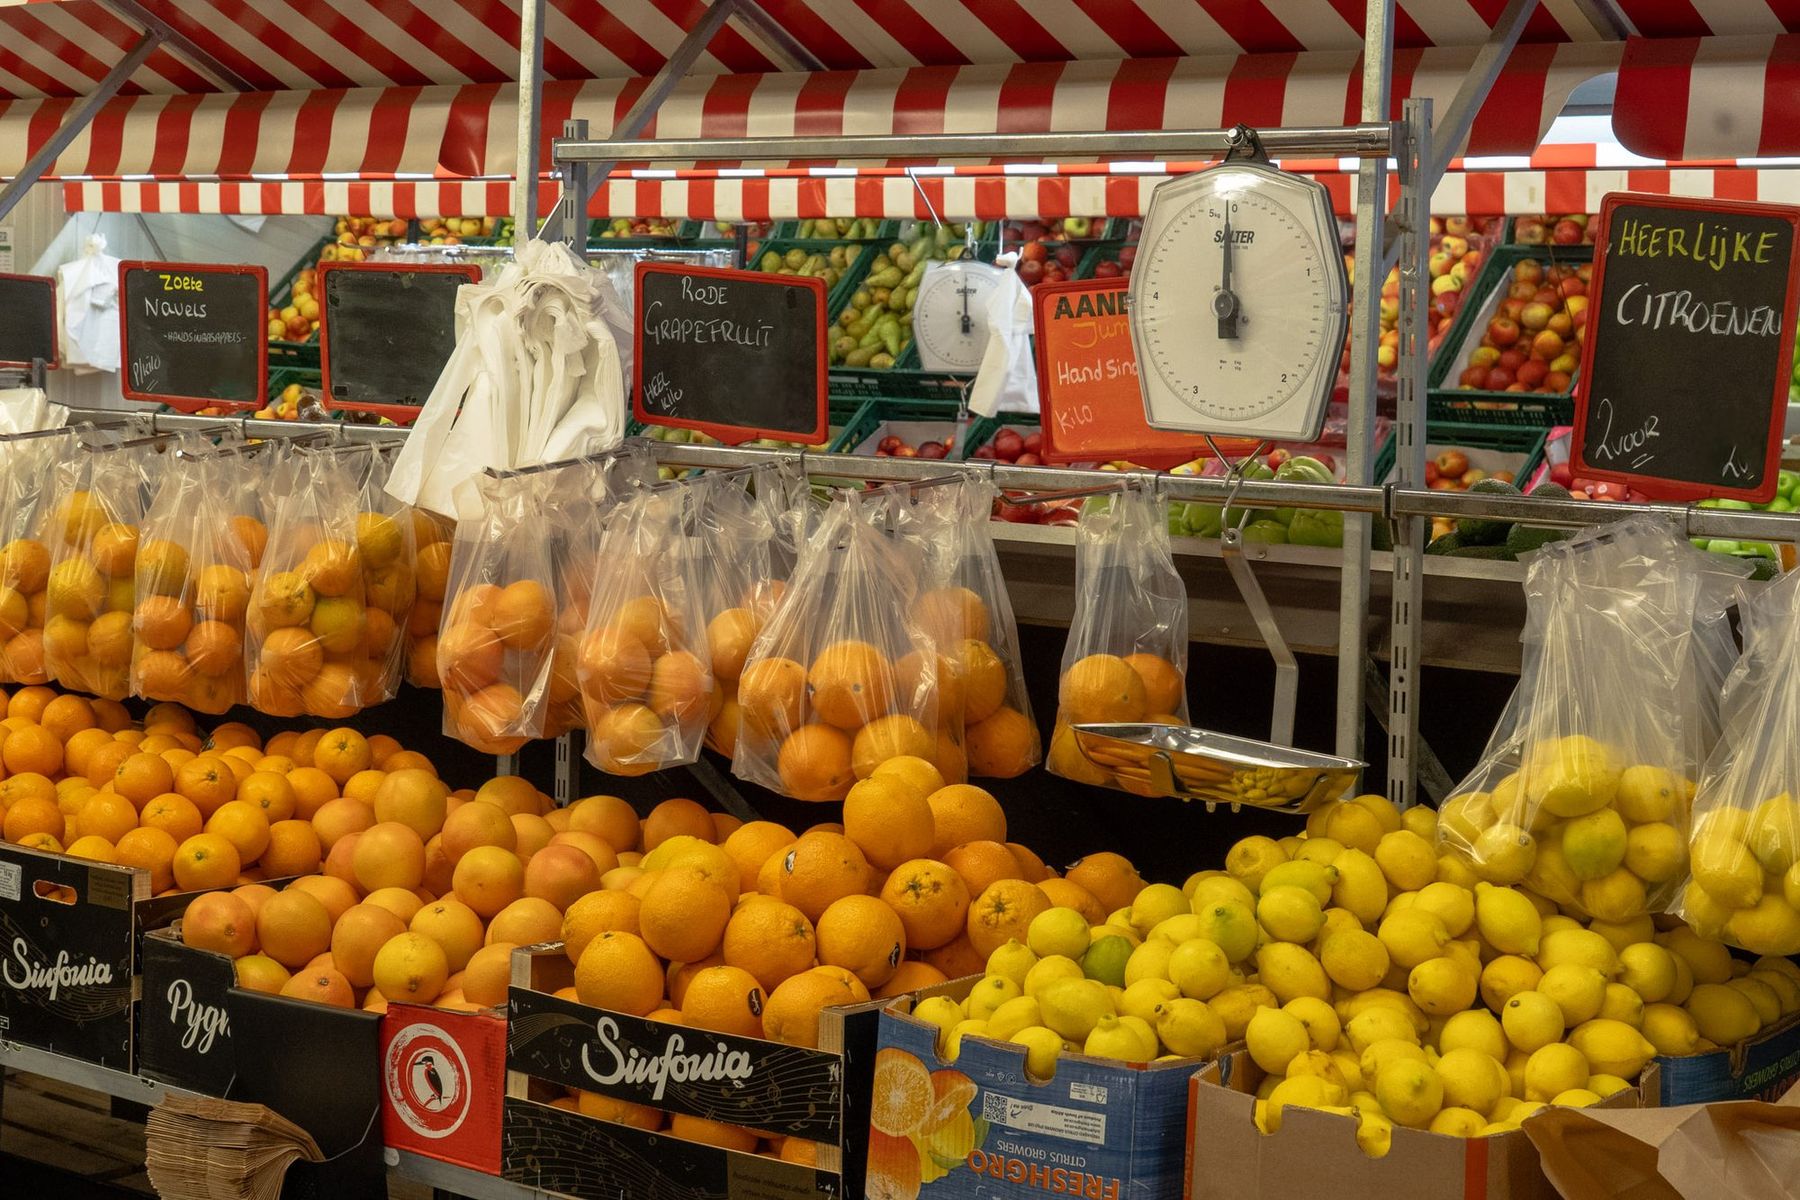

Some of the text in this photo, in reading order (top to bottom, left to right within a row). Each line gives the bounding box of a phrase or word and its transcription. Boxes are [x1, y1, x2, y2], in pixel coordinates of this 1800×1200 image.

[159, 274, 204, 292] Zoete
[3, 937, 113, 1001] Sinfonia
[581, 1016, 753, 1101] Sinfonia
[967, 1148, 1120, 1200] FRESHGRO
[996, 1139, 1086, 1168] CITRUS GROWERS
